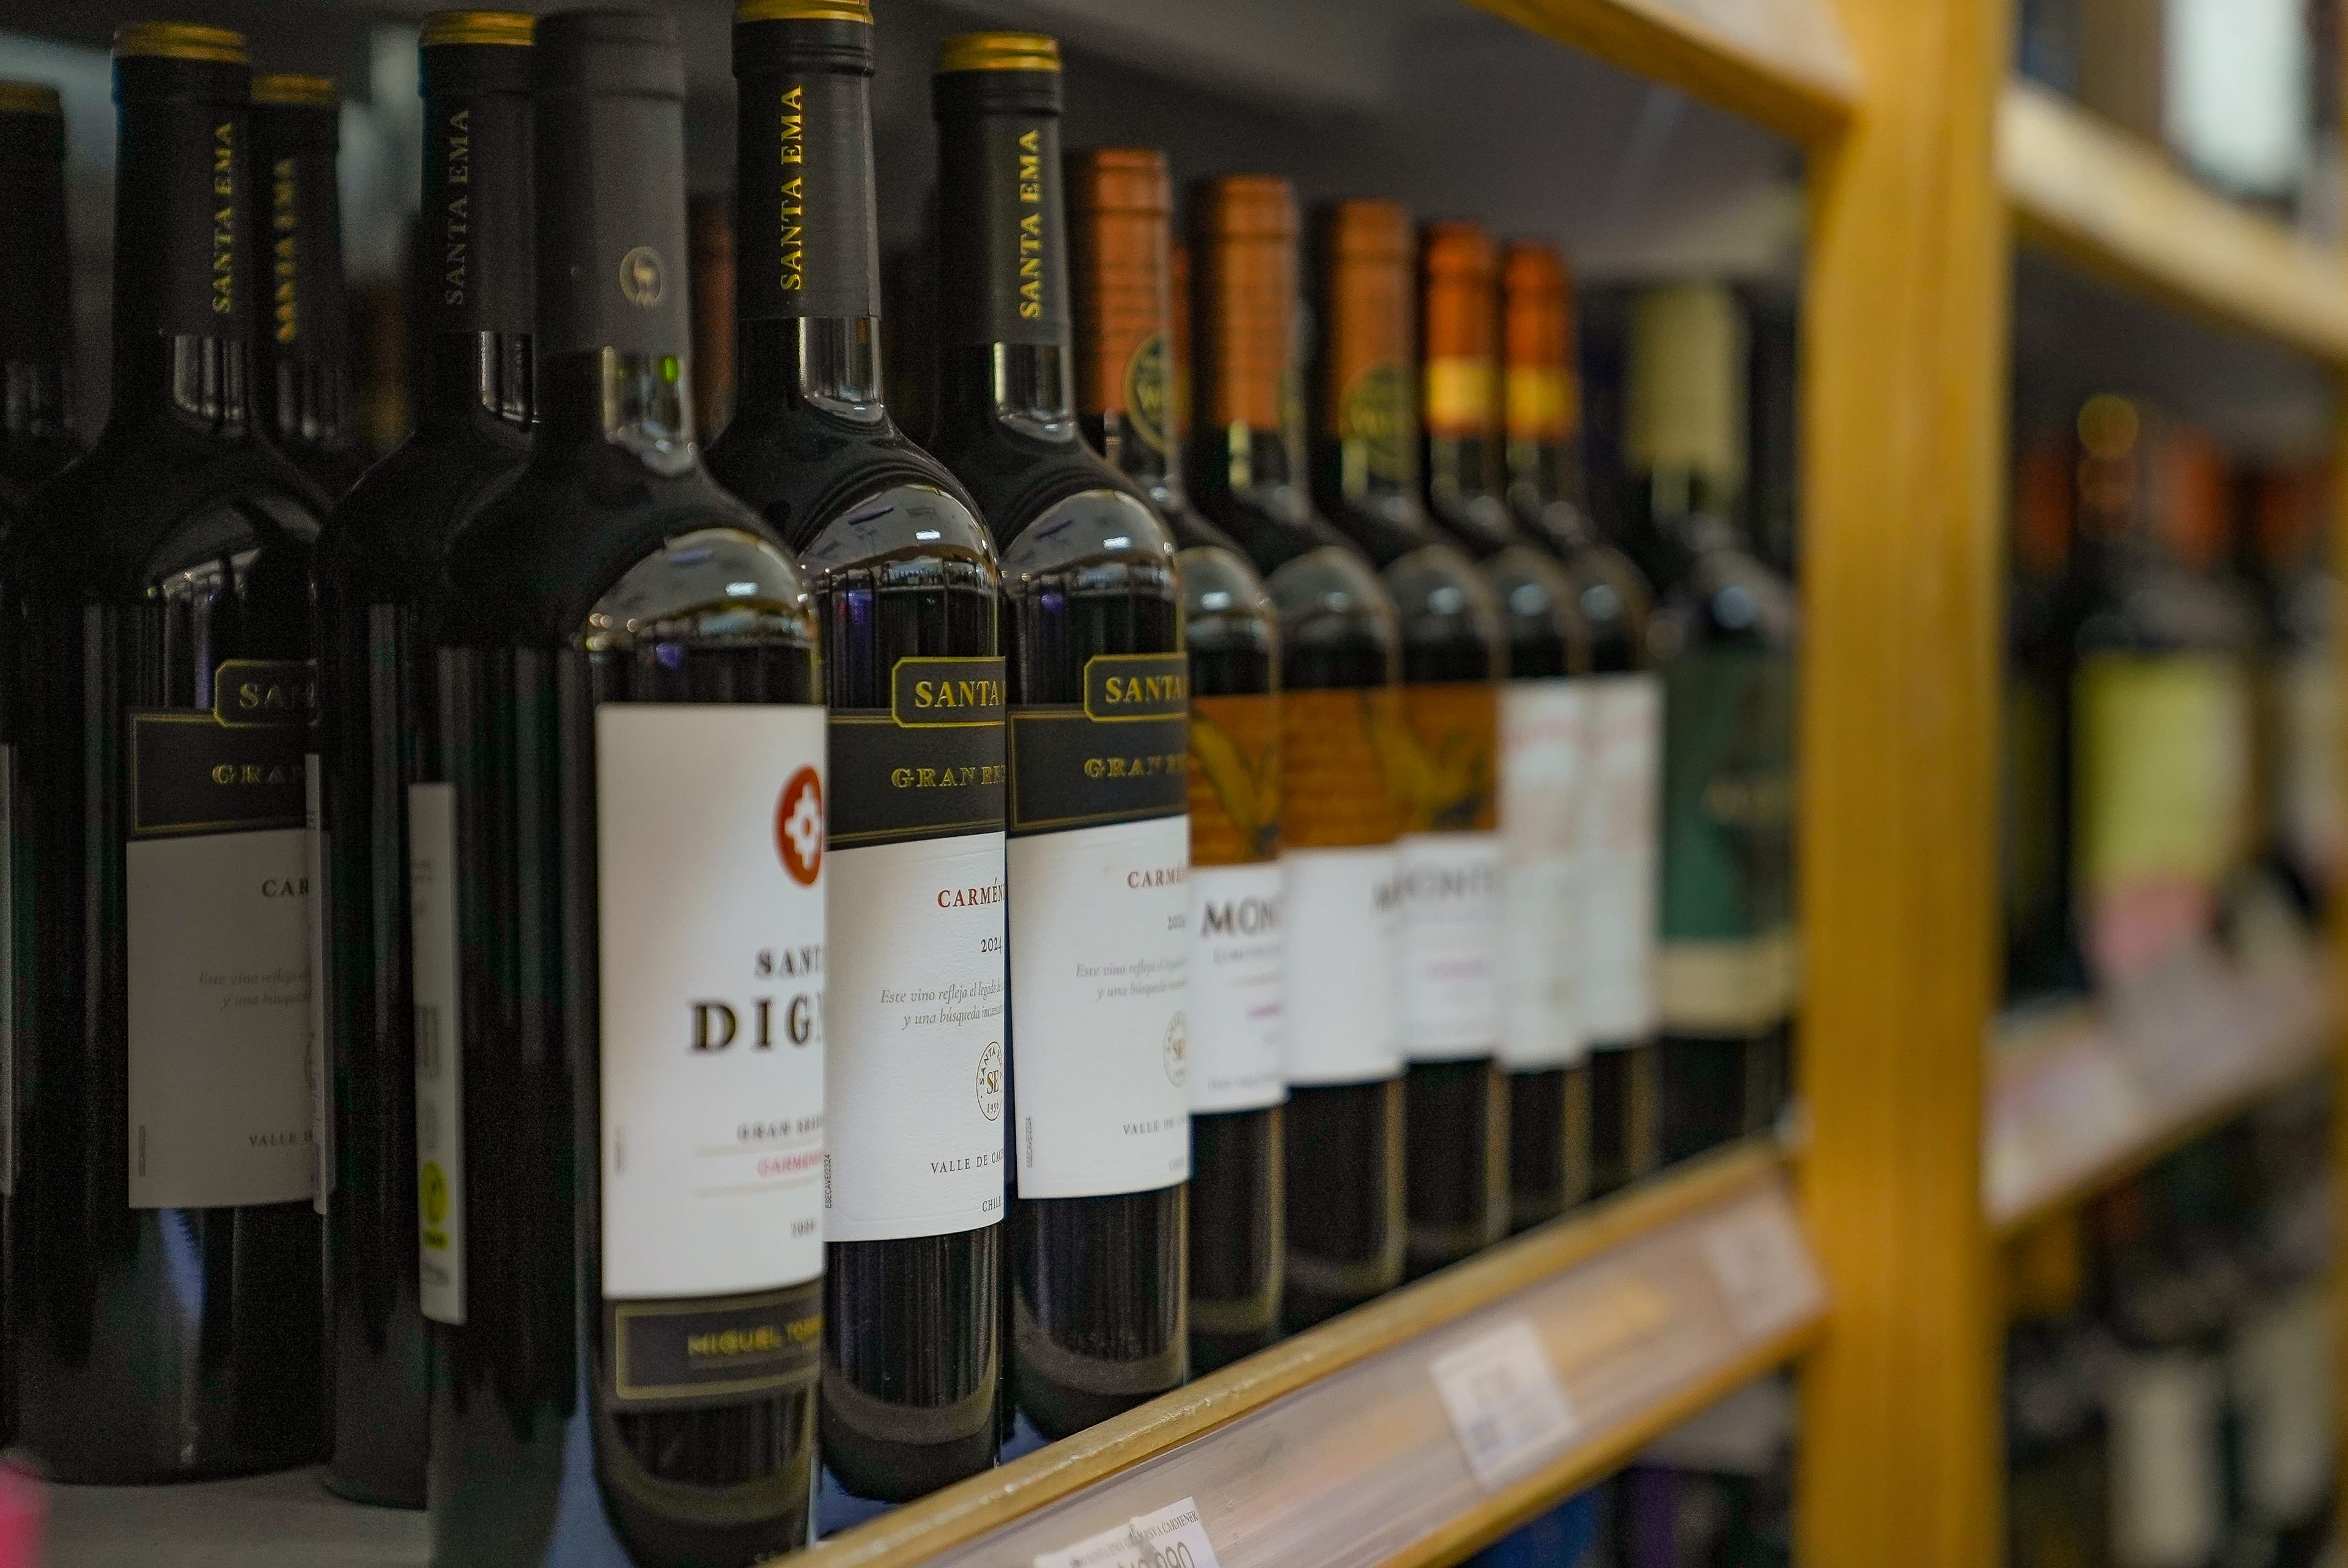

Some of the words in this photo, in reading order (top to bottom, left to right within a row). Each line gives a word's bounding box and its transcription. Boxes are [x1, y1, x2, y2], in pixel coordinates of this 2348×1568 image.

[215, 122, 234, 197] EMA
[449, 109, 469, 184] EMA
[780, 84, 802, 166] EMA
[1019, 129, 1039, 202] EMA
[213, 207, 234, 314] SANTA
[445, 194, 468, 305] SANTA
[780, 176, 802, 292] SANTA
[1019, 214, 1041, 320] SANTA
[914, 680, 1000, 708] SANTA
[891, 767, 976, 788] GRAN
[880, 989, 906, 1004] Este
[910, 988, 935, 1002] vino
[939, 984, 967, 1004] refleja
[970, 982, 976, 998] el
[901, 1015, 910, 1031] y
[915, 1013, 936, 1025] una
[940, 1004, 980, 1027] búsqueda
[979, 1046, 996, 1086] SANTA
[929, 1158, 971, 1174] VALLE
[976, 1154, 988, 1168] DE
[982, 1195, 1002, 1213] CHILE
